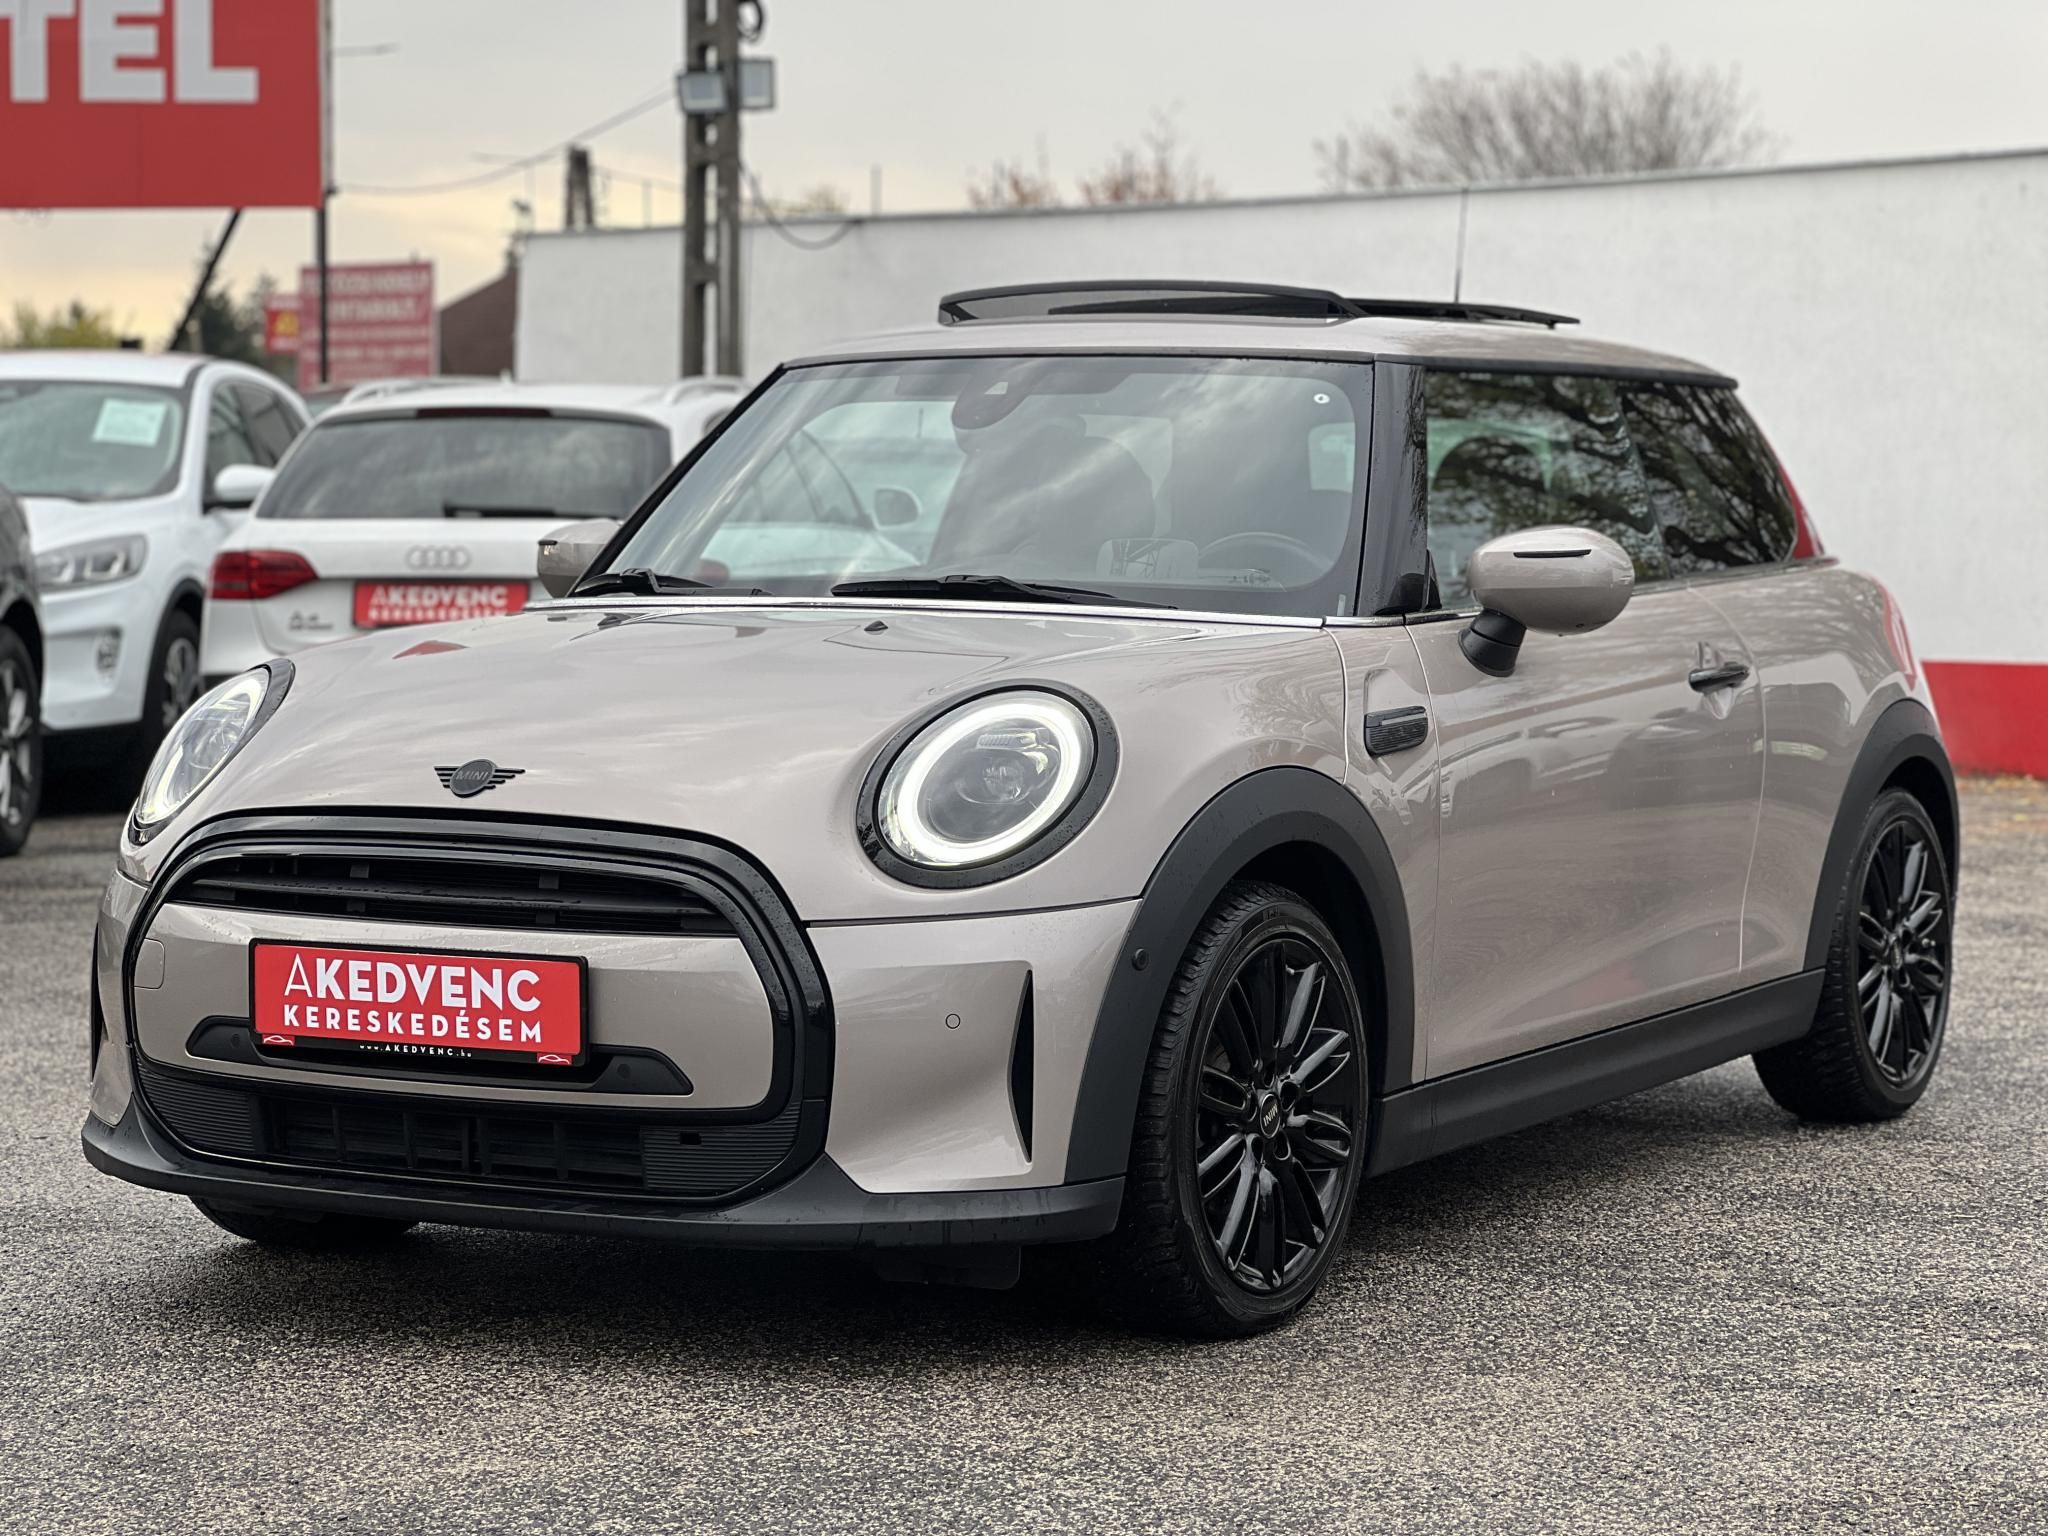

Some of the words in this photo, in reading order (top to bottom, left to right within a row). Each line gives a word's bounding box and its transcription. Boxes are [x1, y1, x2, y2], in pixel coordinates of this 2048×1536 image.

[455, 771, 488, 780] MINI
[284, 953, 542, 1013] AKEDVENC
[284, 1004, 542, 1043] KERESKEDÉSEM
